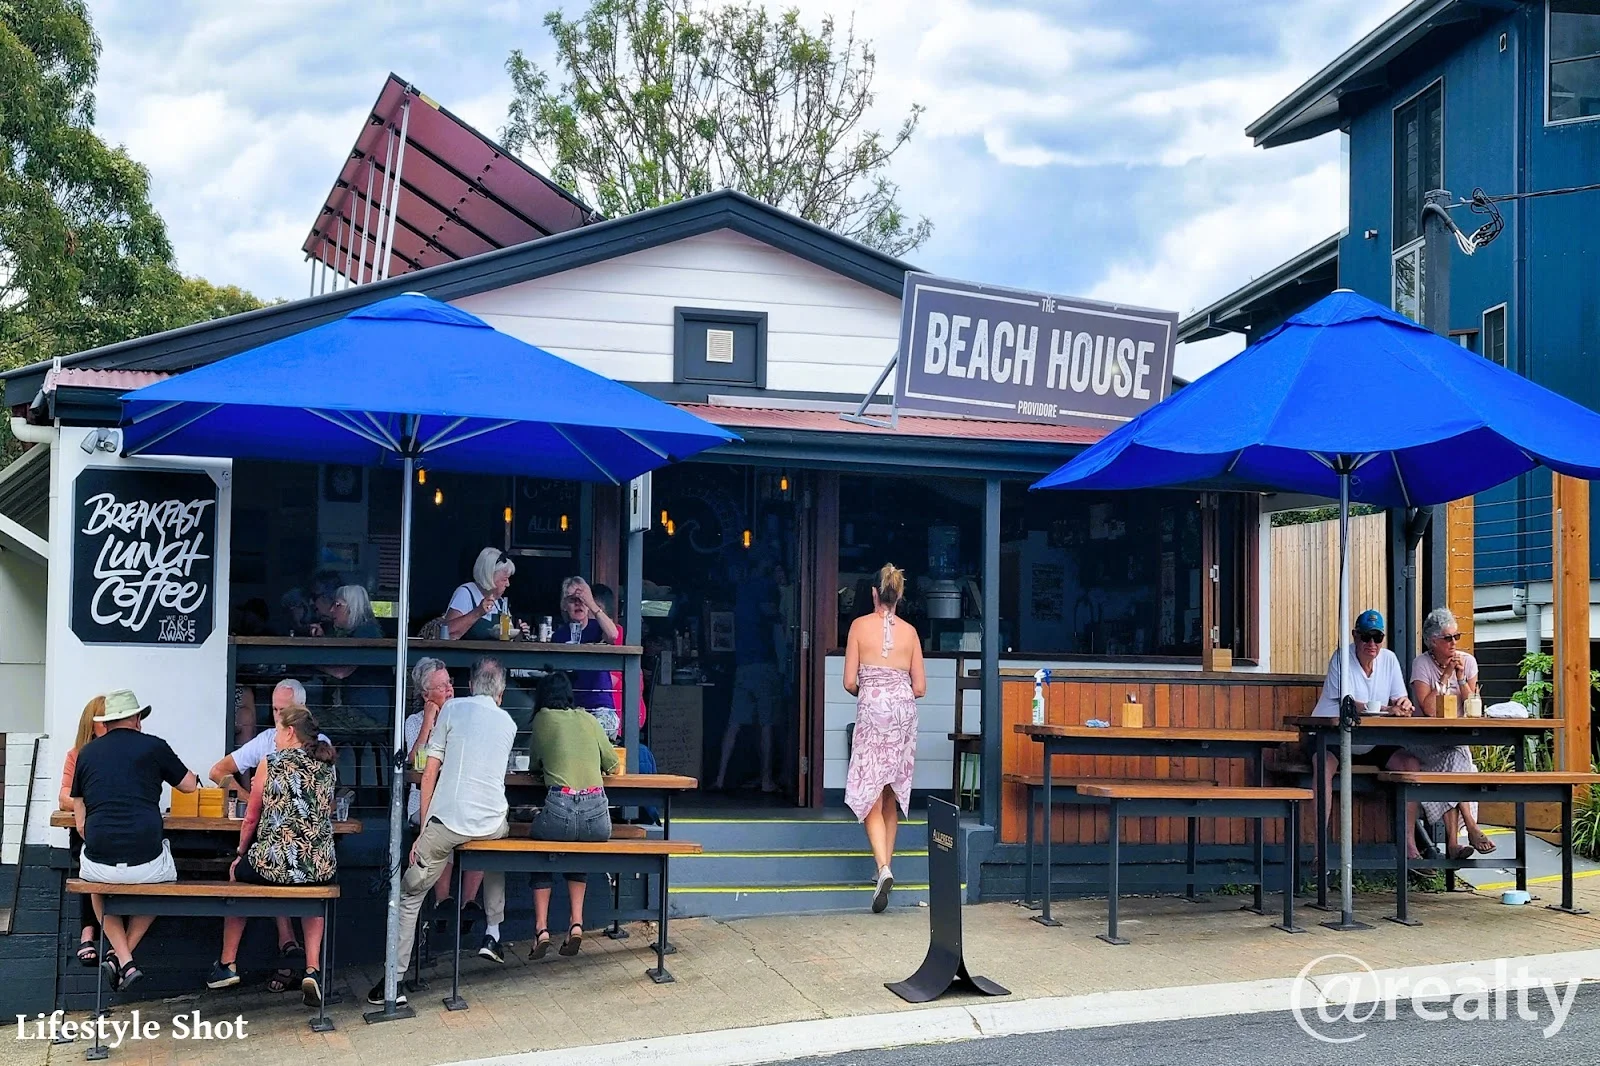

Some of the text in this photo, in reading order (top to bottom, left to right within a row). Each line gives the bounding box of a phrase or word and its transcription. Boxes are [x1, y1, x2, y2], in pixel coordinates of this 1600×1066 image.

[1041, 298, 1056, 313] THE
[924, 311, 1155, 400] BEACH HOUSE
[1017, 400, 1058, 418] PROVIDORE
[81, 493, 215, 539] BREAKFAST
[94, 531, 210, 578] LUNCH
[91, 567, 207, 632] Coffee
[158, 630, 196, 642] AWAYS
[159, 619, 196, 631] TAKE
